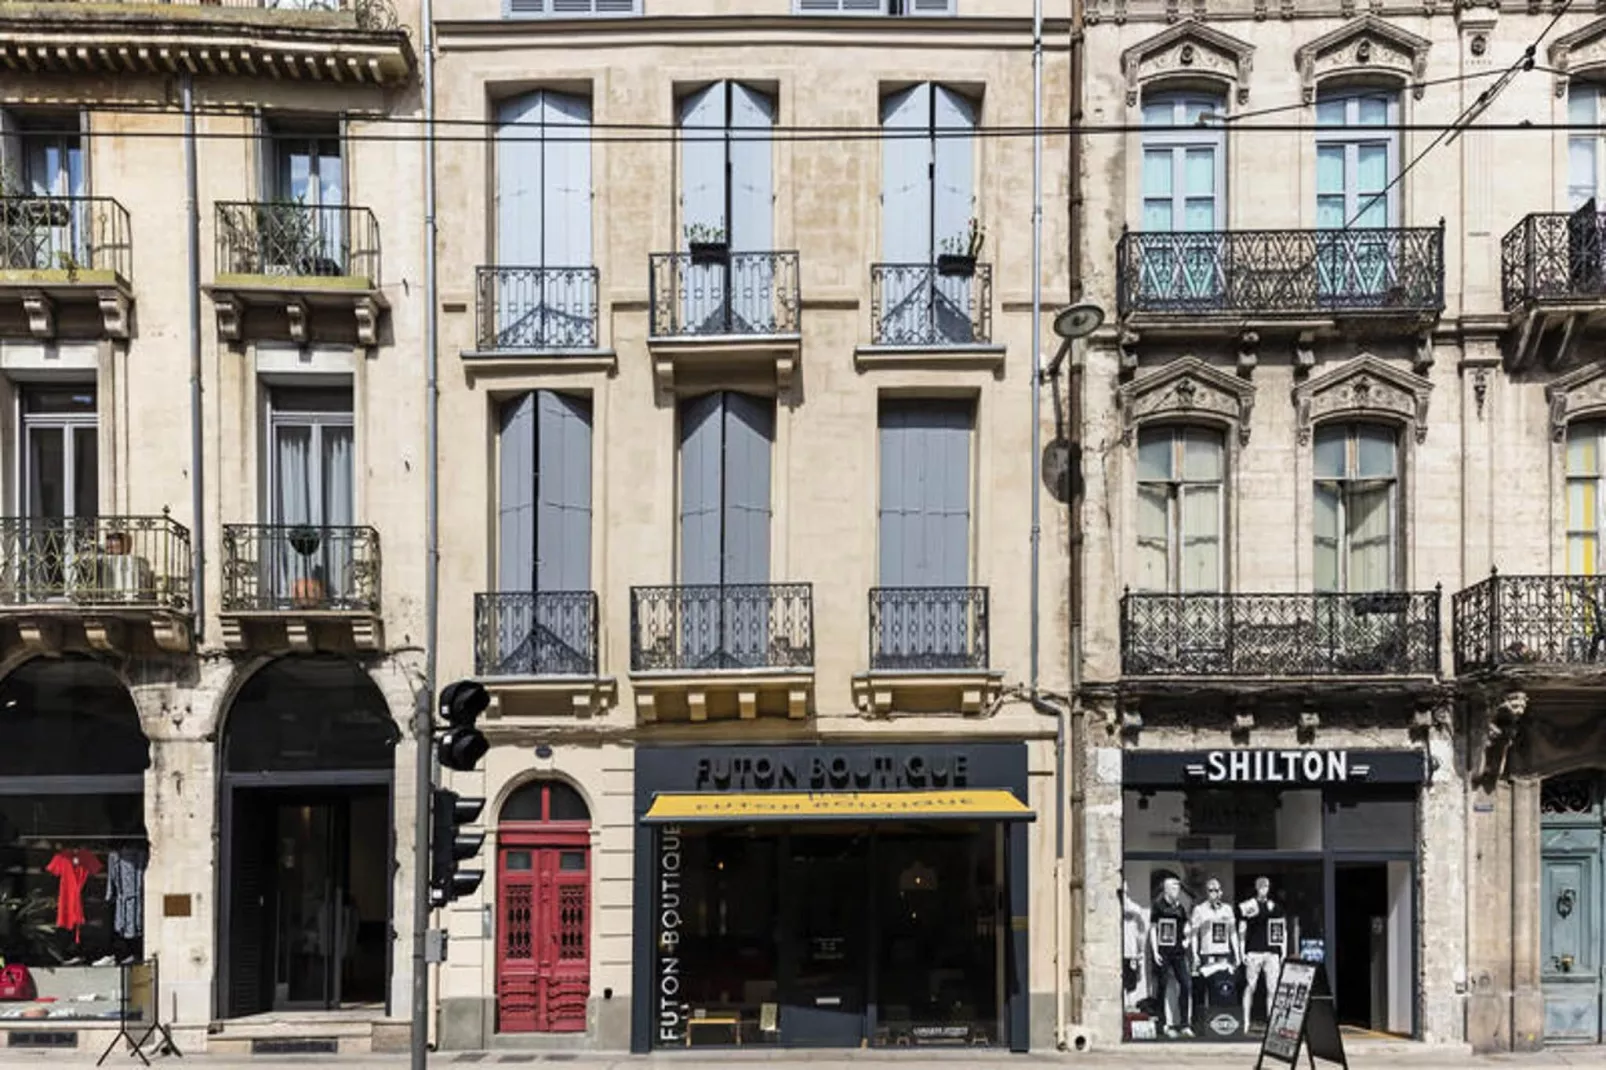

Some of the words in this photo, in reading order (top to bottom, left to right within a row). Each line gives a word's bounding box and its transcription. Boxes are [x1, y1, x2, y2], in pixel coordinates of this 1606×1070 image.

[697, 756, 798, 790] FUTON
[811, 754, 968, 789] BOUTIQUE
[1208, 750, 1347, 781] SHILTON
[661, 824, 683, 945] BOUTIQUE
[660, 957, 680, 1040] FUTON
